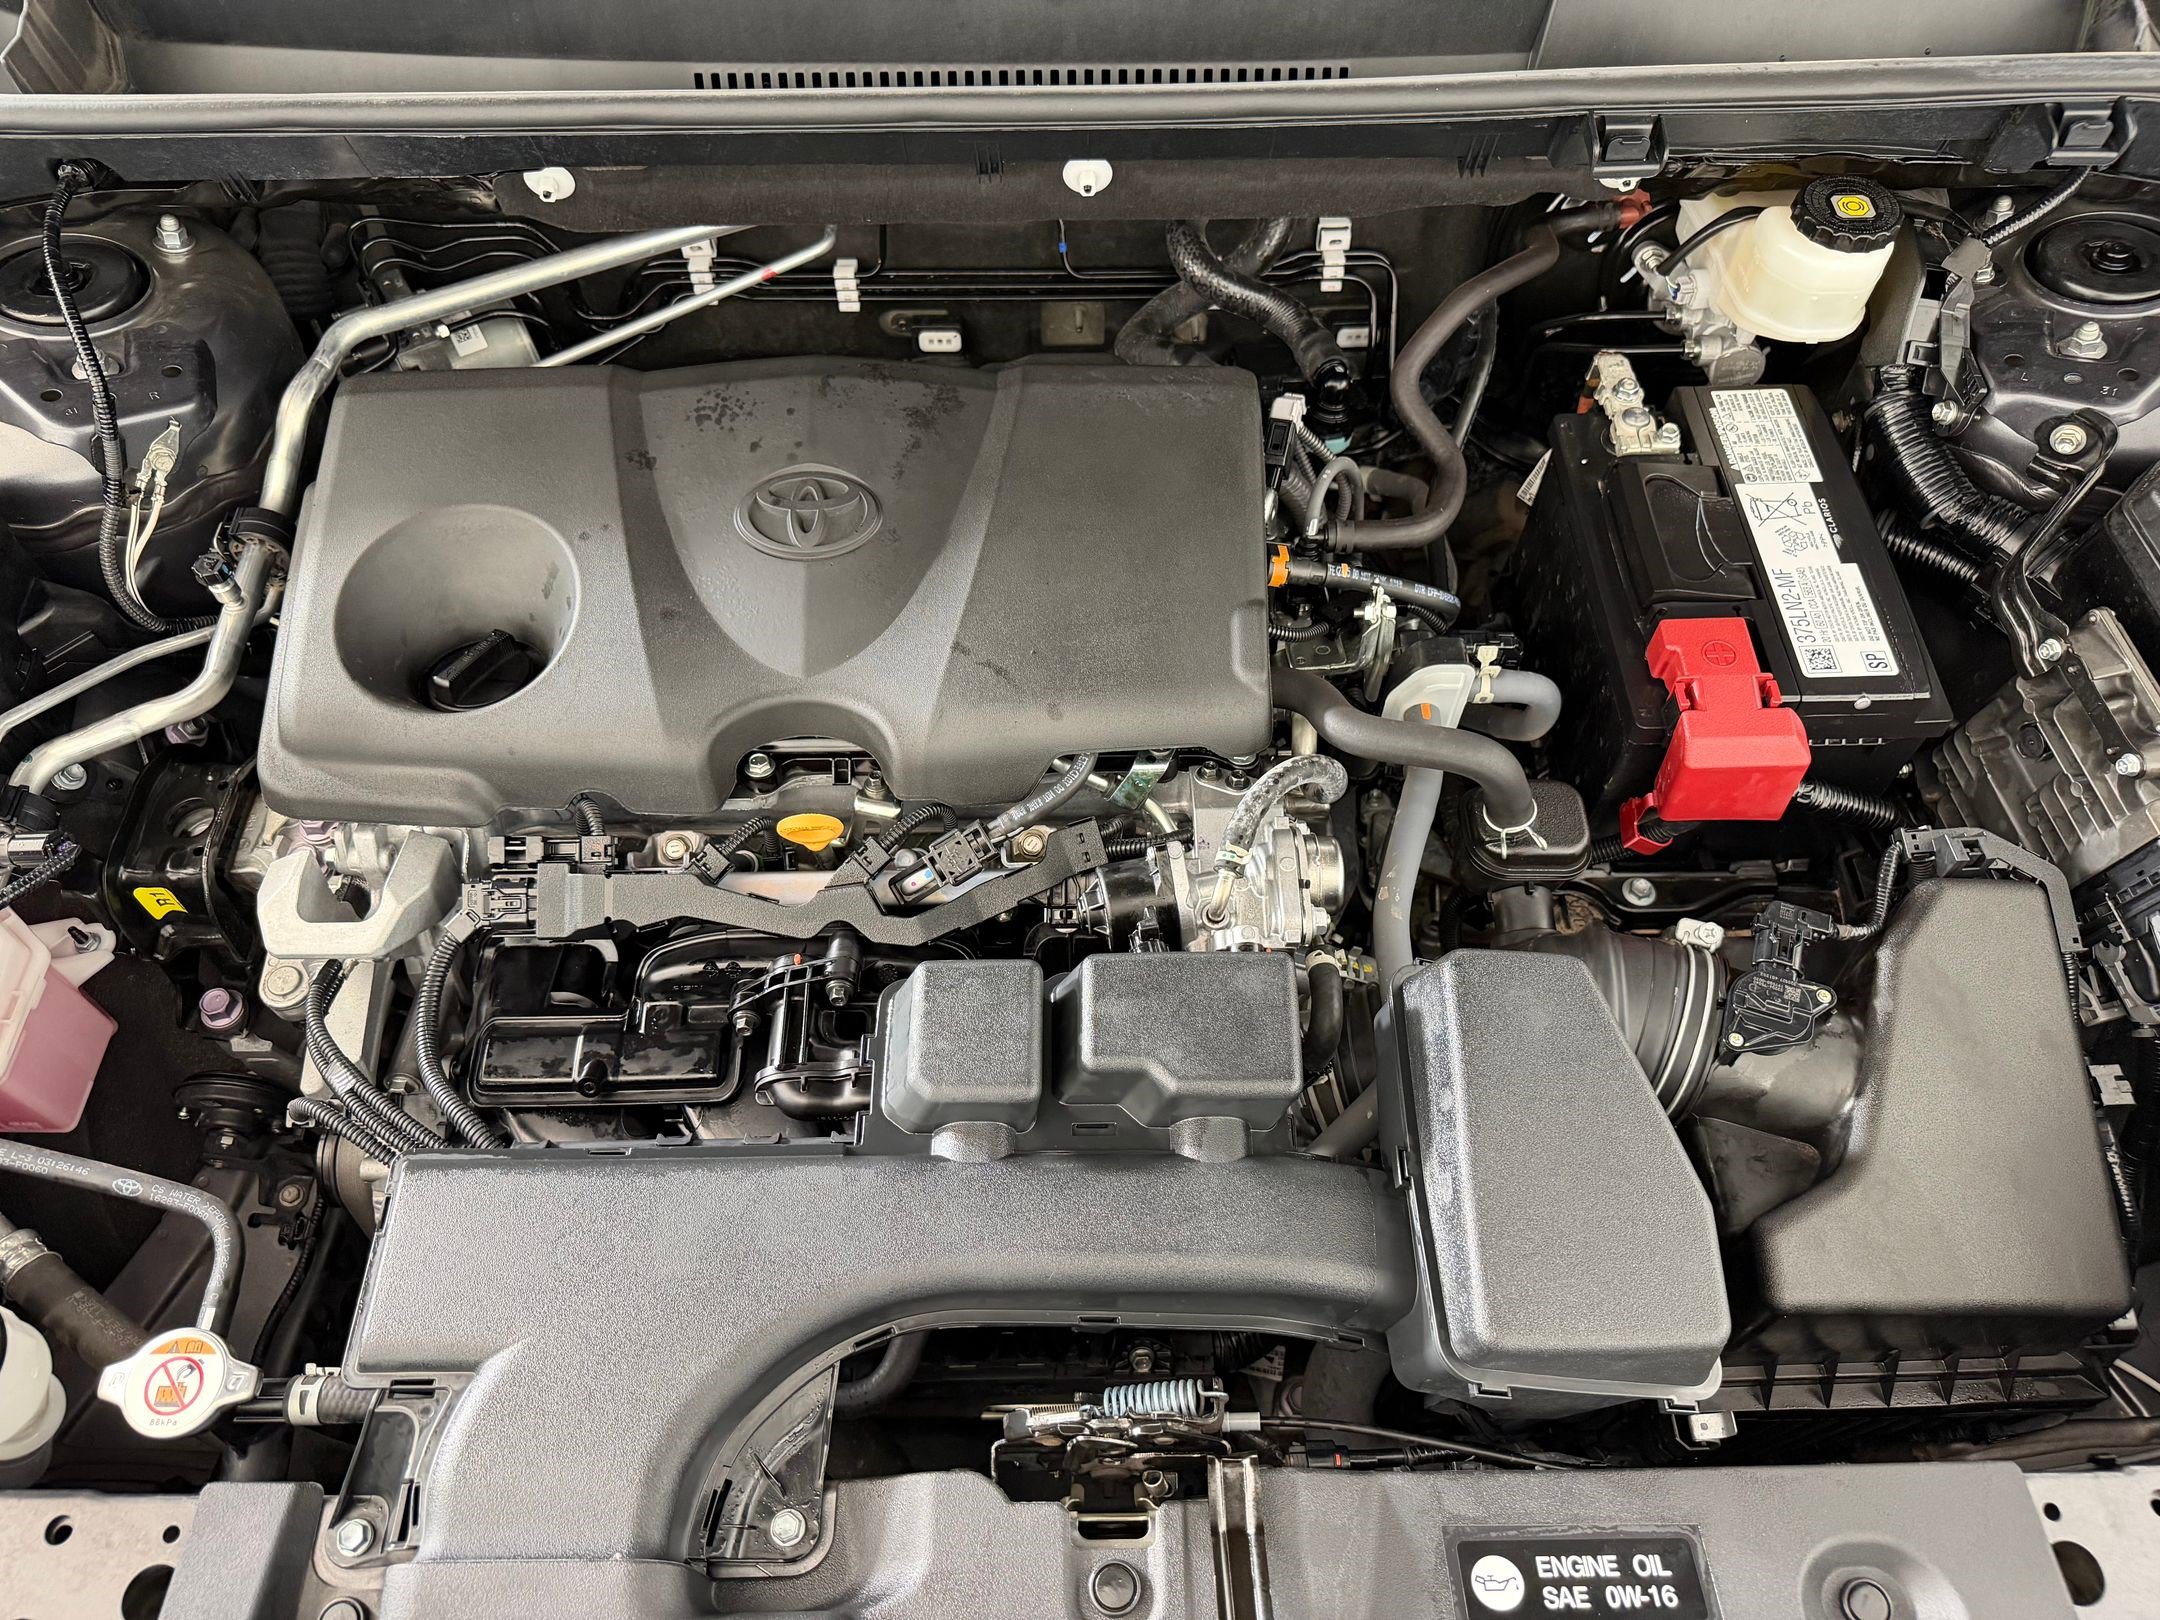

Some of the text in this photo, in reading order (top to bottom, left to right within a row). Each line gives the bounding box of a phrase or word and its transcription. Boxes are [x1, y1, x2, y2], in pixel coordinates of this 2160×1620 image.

[1802, 501, 1816, 514] Pb
[1818, 498, 1838, 533] CLARIOS
[1772, 568, 1817, 643] 375LN2-MF
[1866, 653, 1888, 669] SP
[151, 1183, 166, 1195] CS
[169, 1188, 201, 1205] WATER
[1535, 1553, 1673, 1578] ENGINE OIL
[1542, 1584, 1679, 1610] SAE 0W-16
